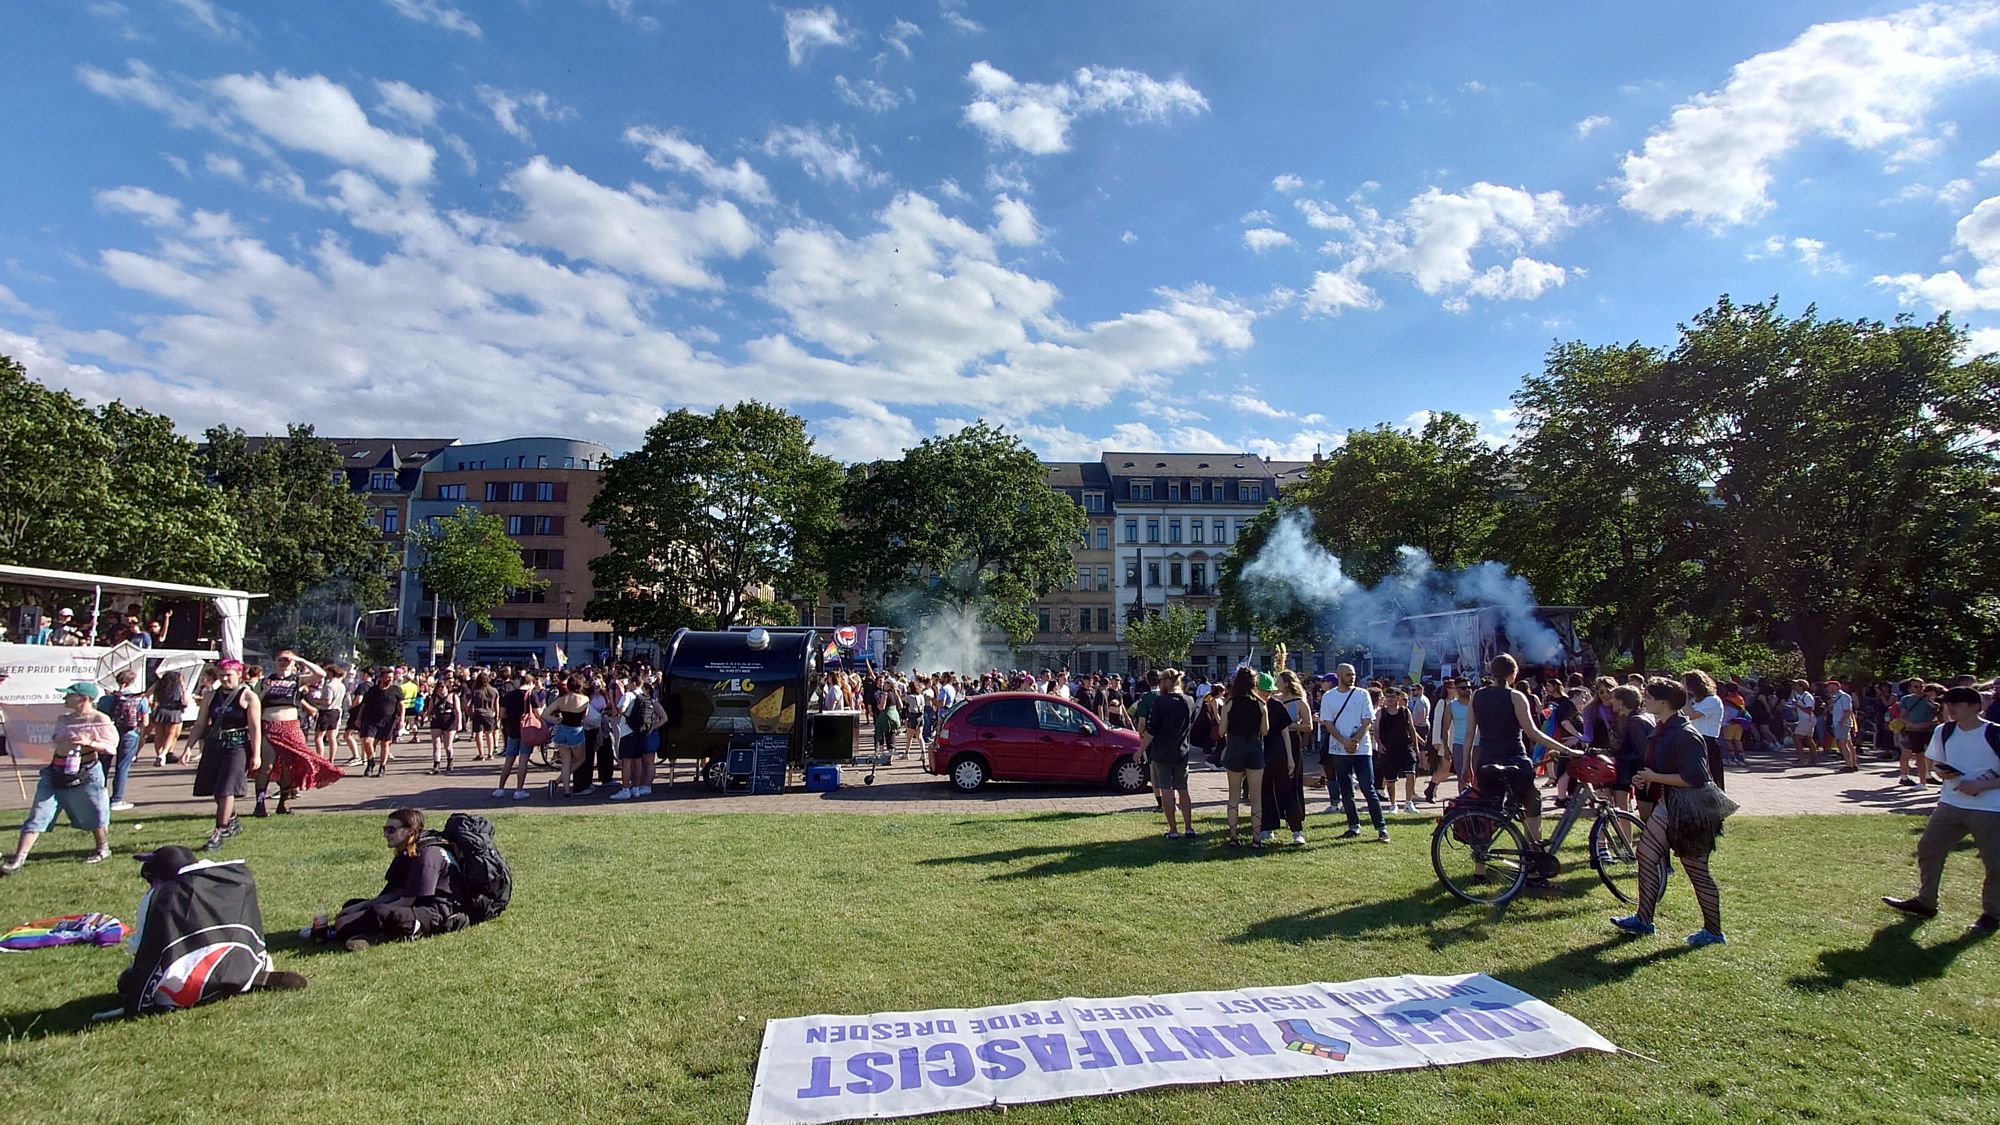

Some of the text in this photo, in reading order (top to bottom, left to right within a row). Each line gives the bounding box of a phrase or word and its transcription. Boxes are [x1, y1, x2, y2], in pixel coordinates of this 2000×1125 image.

[27, 665, 56, 674] PRIDE
[713, 678, 755, 692] MEG
[1327, 988, 1394, 1007] AND
[1394, 984, 1488, 1001] UNITE
[1072, 1002, 1173, 1023] QUEER
[1215, 995, 1326, 1014] RESIST
[969, 1010, 1065, 1034] PRIDE
[806, 1020, 957, 1044] DRESDEN
[797, 1000, 1551, 1099] QUEER ANTIFASCIST
